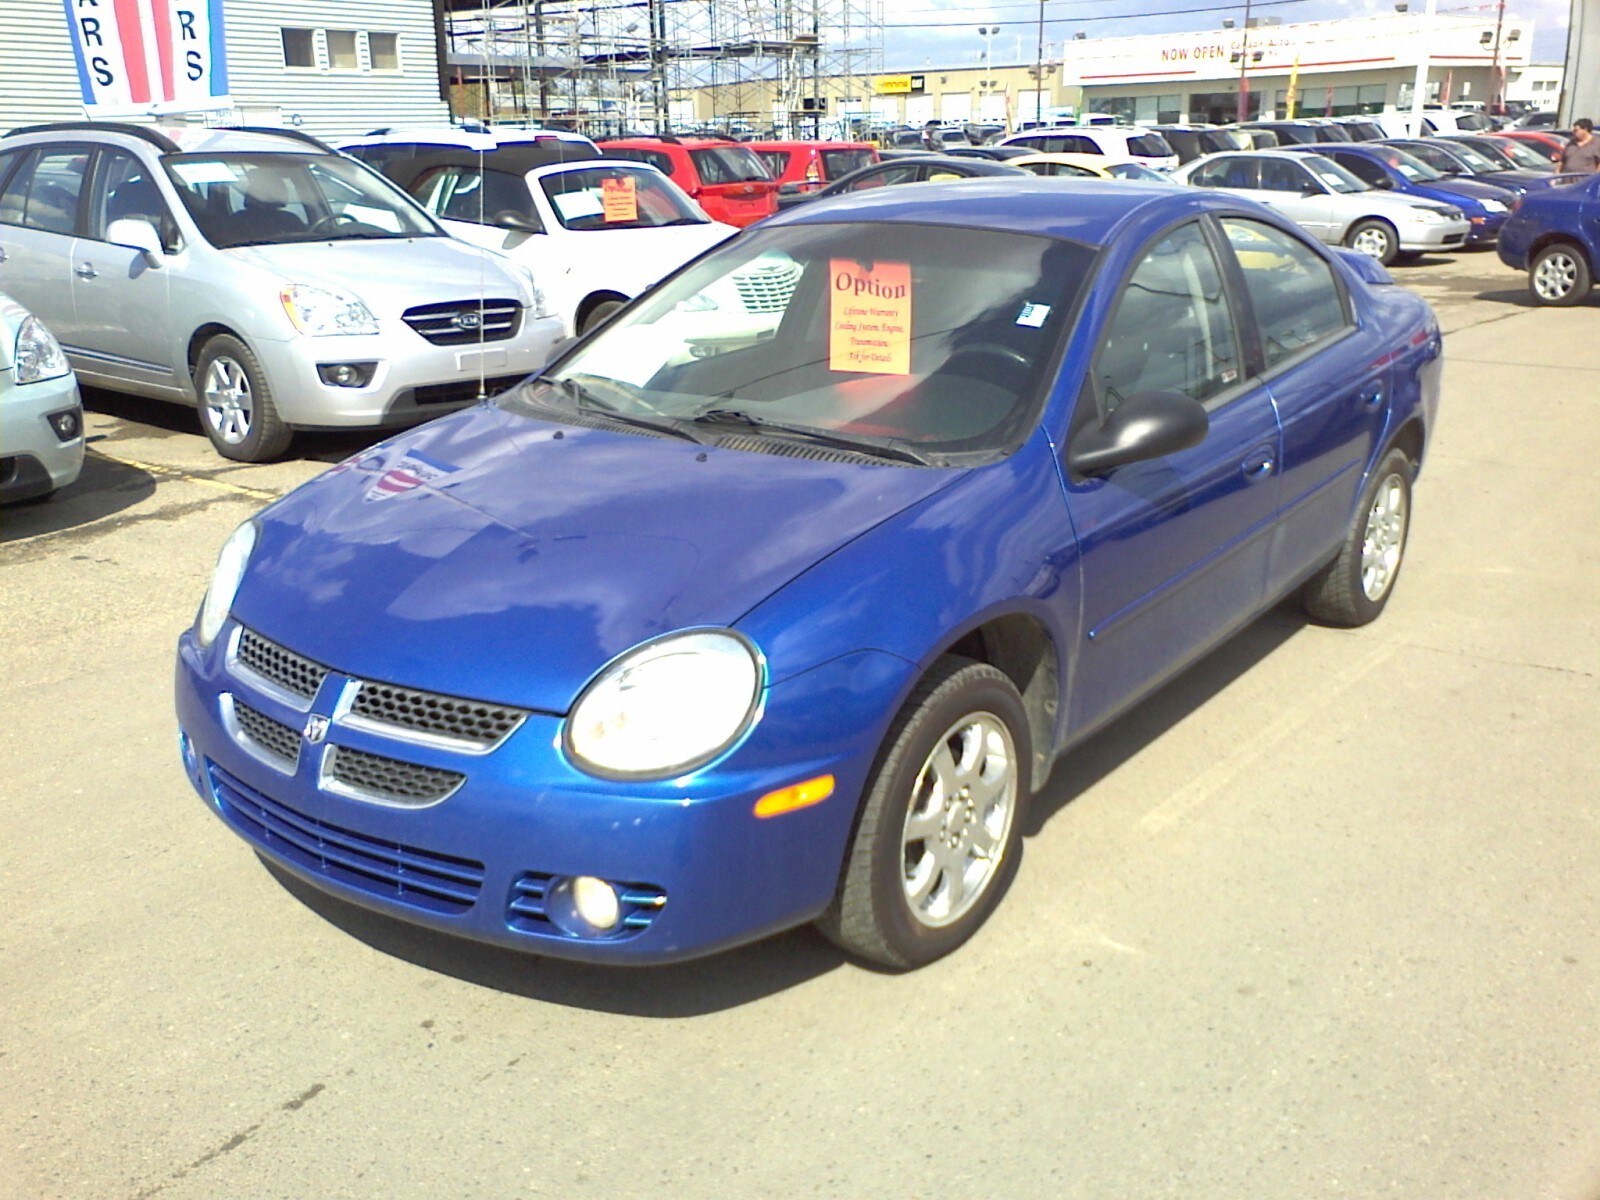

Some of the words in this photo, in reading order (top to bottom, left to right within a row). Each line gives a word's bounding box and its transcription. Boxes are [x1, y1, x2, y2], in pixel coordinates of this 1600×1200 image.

[1162, 48, 1189, 61] NOW
[1193, 45, 1224, 59] OPEN
[836, 272, 905, 299] Option
